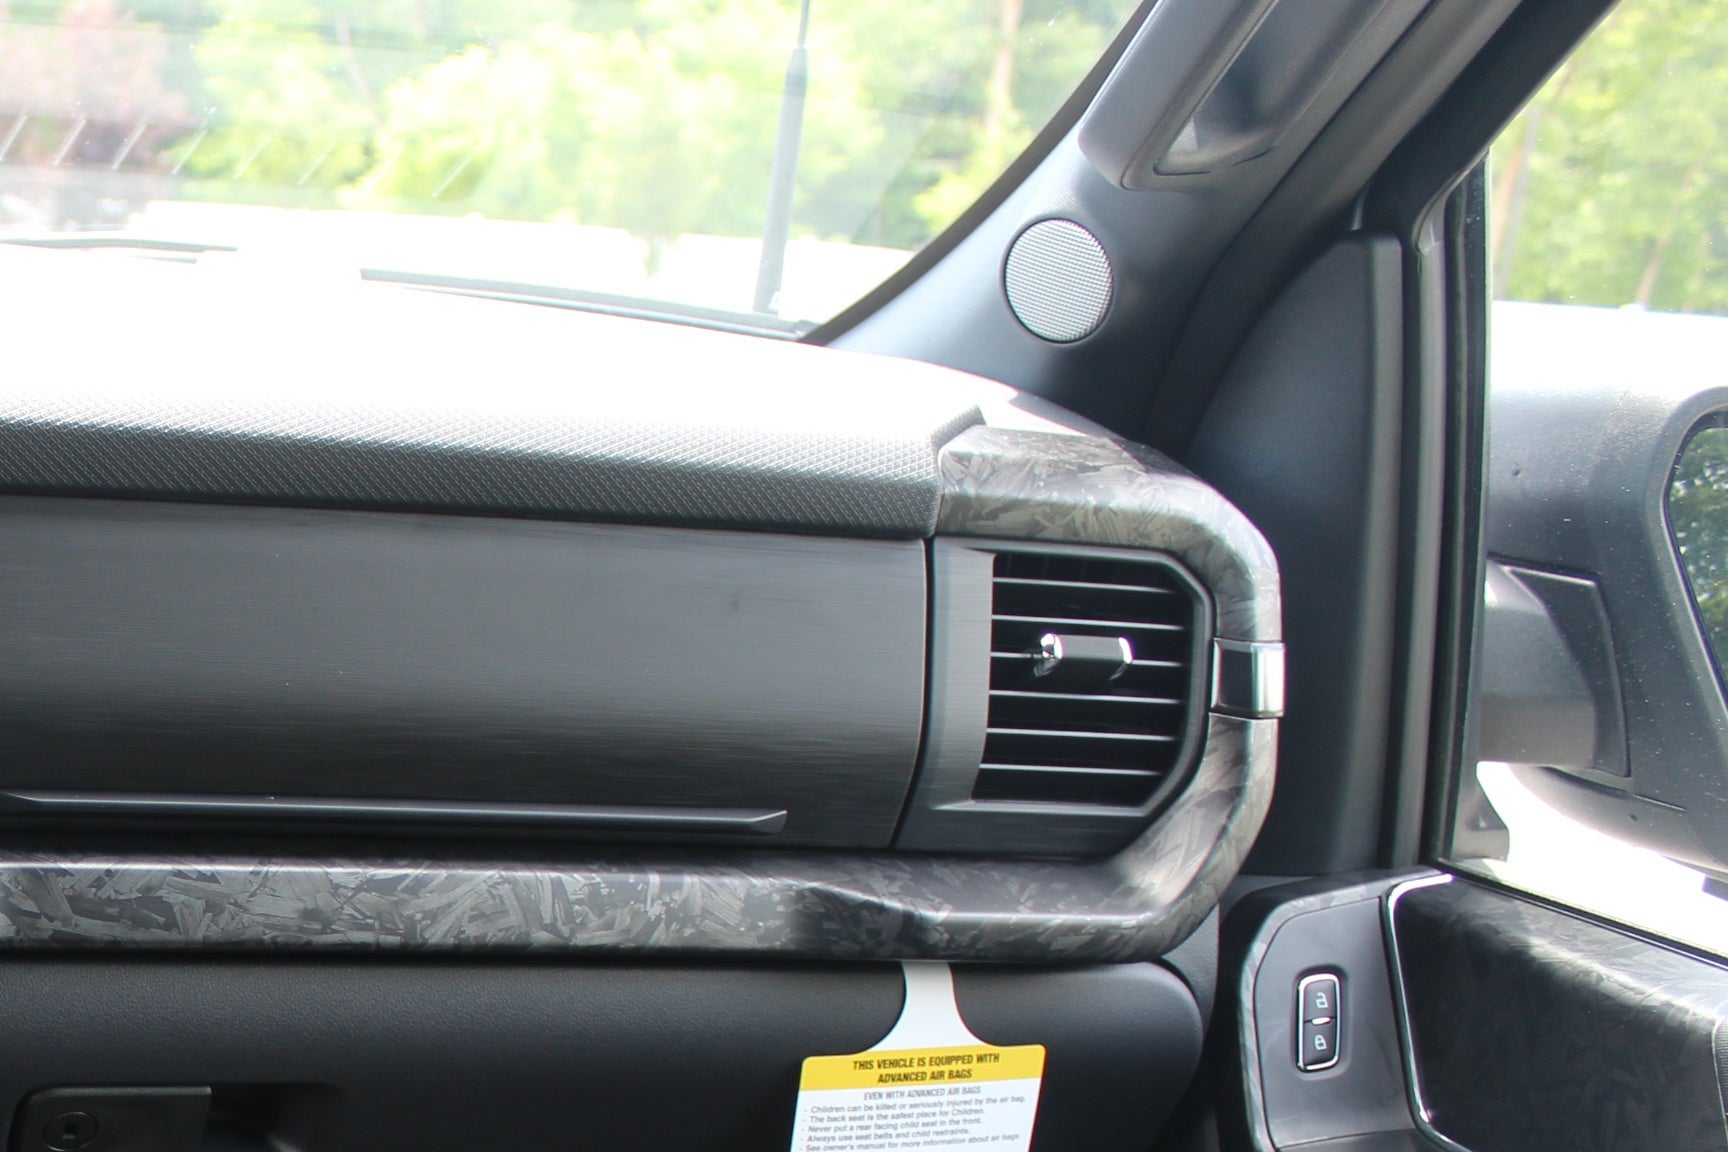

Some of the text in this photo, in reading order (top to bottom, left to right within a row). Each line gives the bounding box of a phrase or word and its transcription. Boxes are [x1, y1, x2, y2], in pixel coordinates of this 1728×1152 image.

[853, 1053, 1000, 1071] THIS VEHICLE IS EQUIPPED WITH
[877, 1069, 973, 1084] ADVANCED AIR BAGS
[863, 1086, 982, 1101] EVEN WITH ADVANCED AIR BAGS
[811, 1105, 845, 1113] Children
[909, 1100, 944, 1109] seriously
[946, 1099, 972, 1108] injured
[974, 1098, 983, 1106] by
[986, 1096, 997, 1104] the
[810, 1115, 824, 1123] The
[848, 1114, 865, 1122] seat
[890, 1112, 914, 1120] safest
[916, 1111, 937, 1119] place
[834, 1125, 847, 1133] put
[874, 1122, 898, 1131] facing
[806, 1144, 821, 1152] See
[823, 1143, 854, 1151] owner's
[856, 1142, 885, 1150] manual
[922, 1138, 966, 1147] information
[968, 1136, 989, 1144] about
[807, 1135, 836, 1143] Always
[855, 1133, 872, 1141] seat
[874, 1132, 893, 1140] belts
